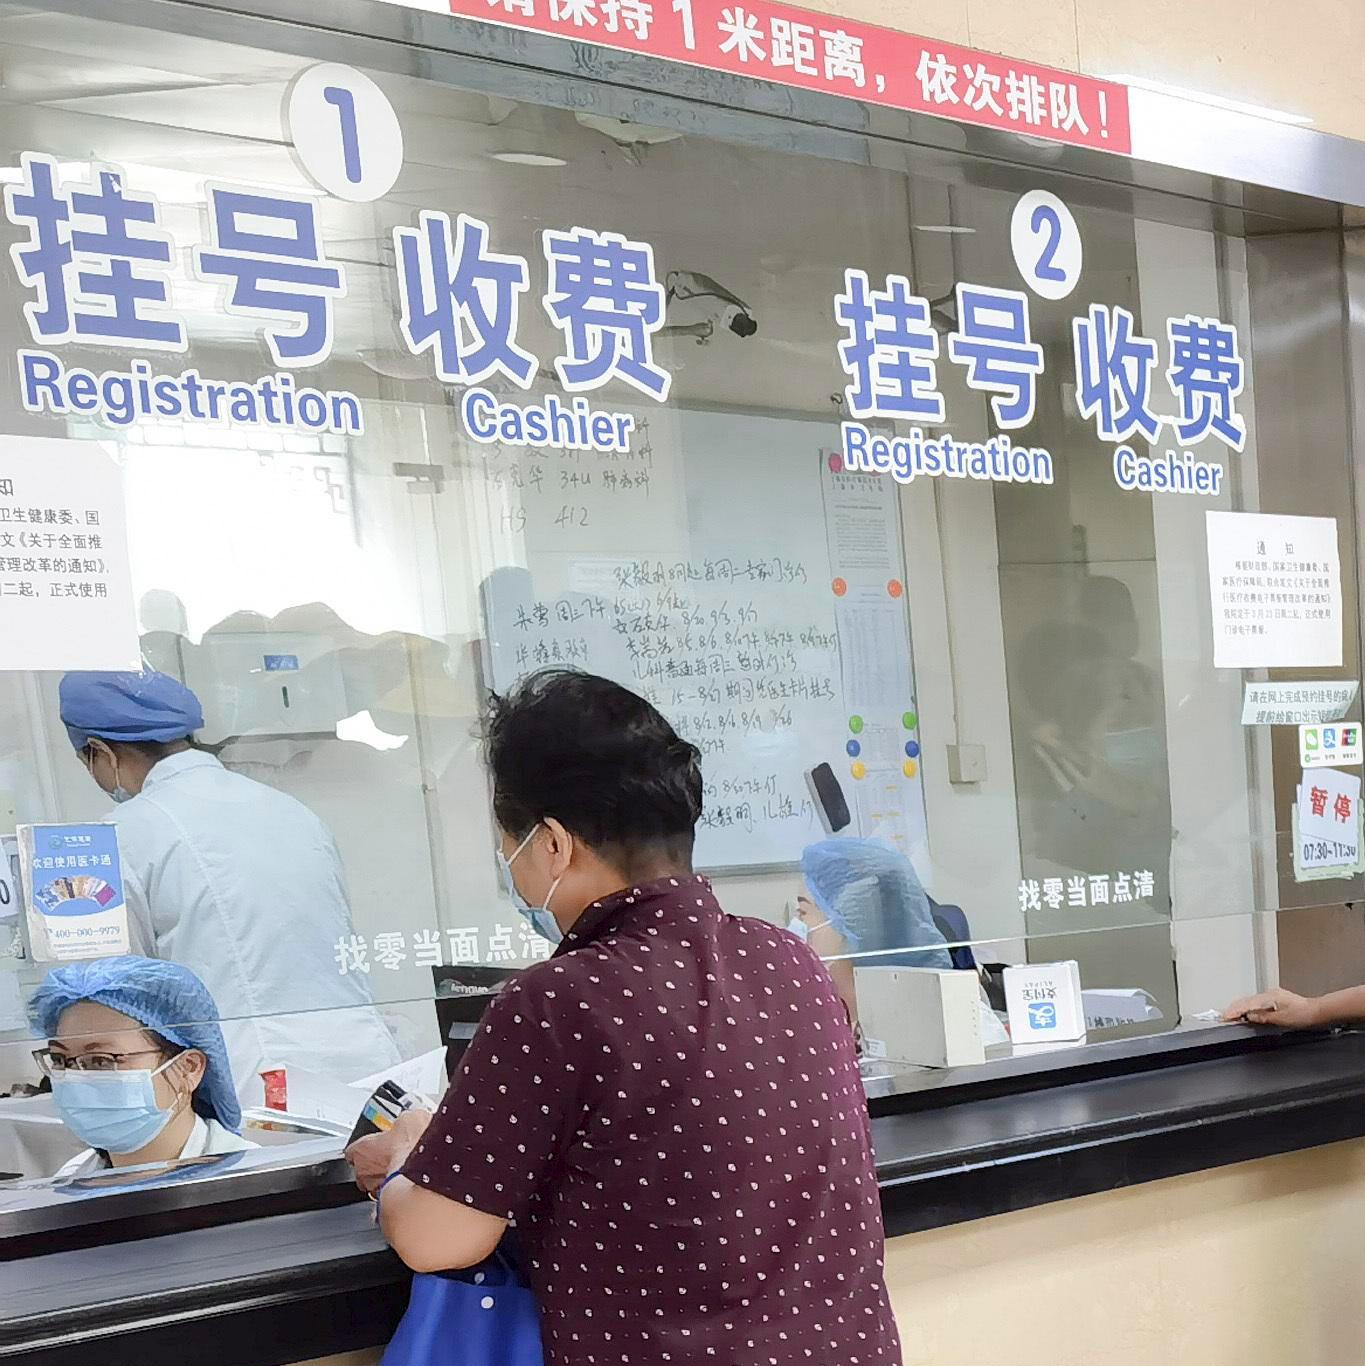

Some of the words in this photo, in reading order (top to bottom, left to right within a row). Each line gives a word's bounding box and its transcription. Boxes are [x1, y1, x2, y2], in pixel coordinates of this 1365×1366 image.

[324, 87, 362, 184] 1
[10, 158, 343, 360] 挂号
[400, 216, 668, 394] 收费
[1032, 204, 1066, 281] 2
[837, 276, 1042, 421] 挂号
[1074, 309, 1243, 445] 收费
[21, 354, 361, 432] Registration
[466, 396, 632, 448] Cashier
[845, 428, 1052, 480] Registration
[1117, 451, 1222, 492] Cashier
[1, 533, 103, 550] 文《关于全面推
[0, 581, 108, 598] 二起，正式使用
[1017, 868, 1155, 912] 找零当面点清
[333, 922, 551, 976] 找零当面点清
